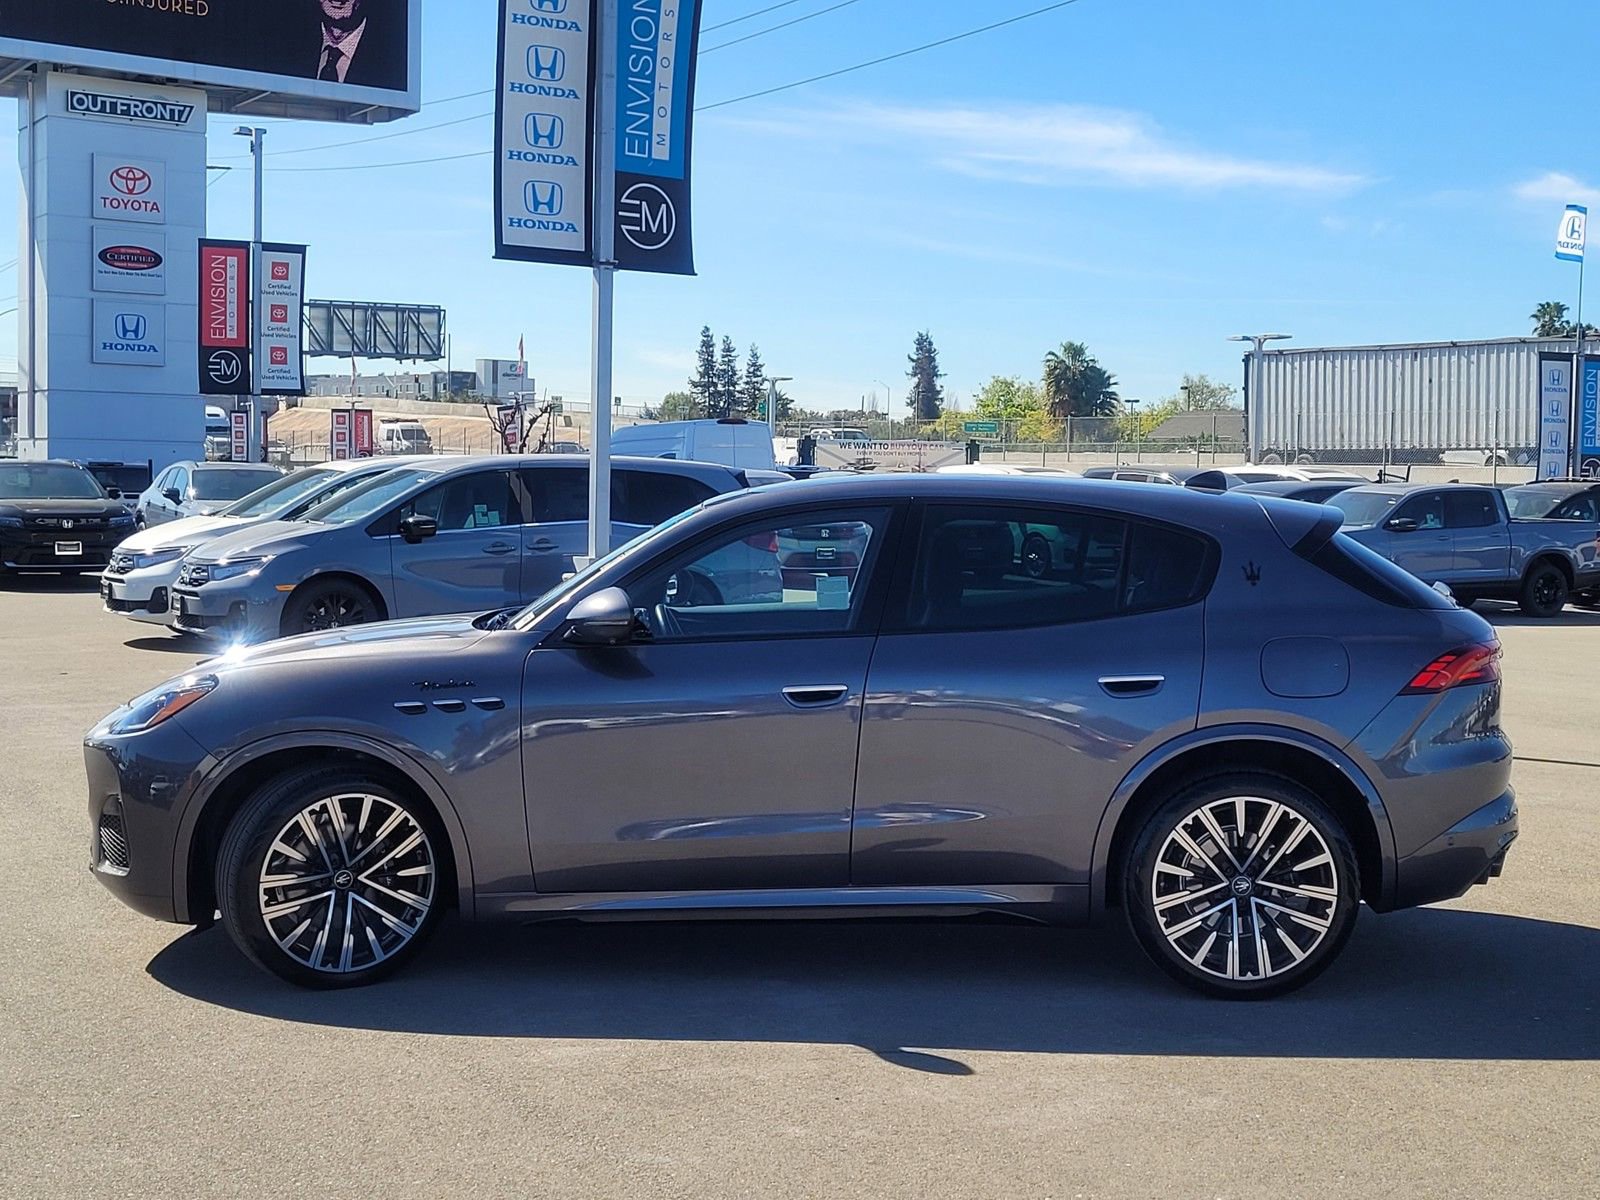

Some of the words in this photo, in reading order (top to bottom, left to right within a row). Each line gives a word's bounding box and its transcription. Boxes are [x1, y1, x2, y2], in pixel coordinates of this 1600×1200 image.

[512, 13, 583, 33] HONDA
[656, 9, 675, 146] MOTORS
[509, 82, 580, 100] HONDA
[507, 150, 579, 167] HONDA
[101, 197, 160, 213] TOYOTA
[507, 217, 578, 233] HONDA
[210, 255, 226, 339] ENVISION
[102, 342, 158, 352] HONDA
[1584, 369, 1597, 447] ENVISION
[840, 442, 852, 450] WE
[853, 442, 877, 450] WANT
[907, 443, 928, 451] YOUR
